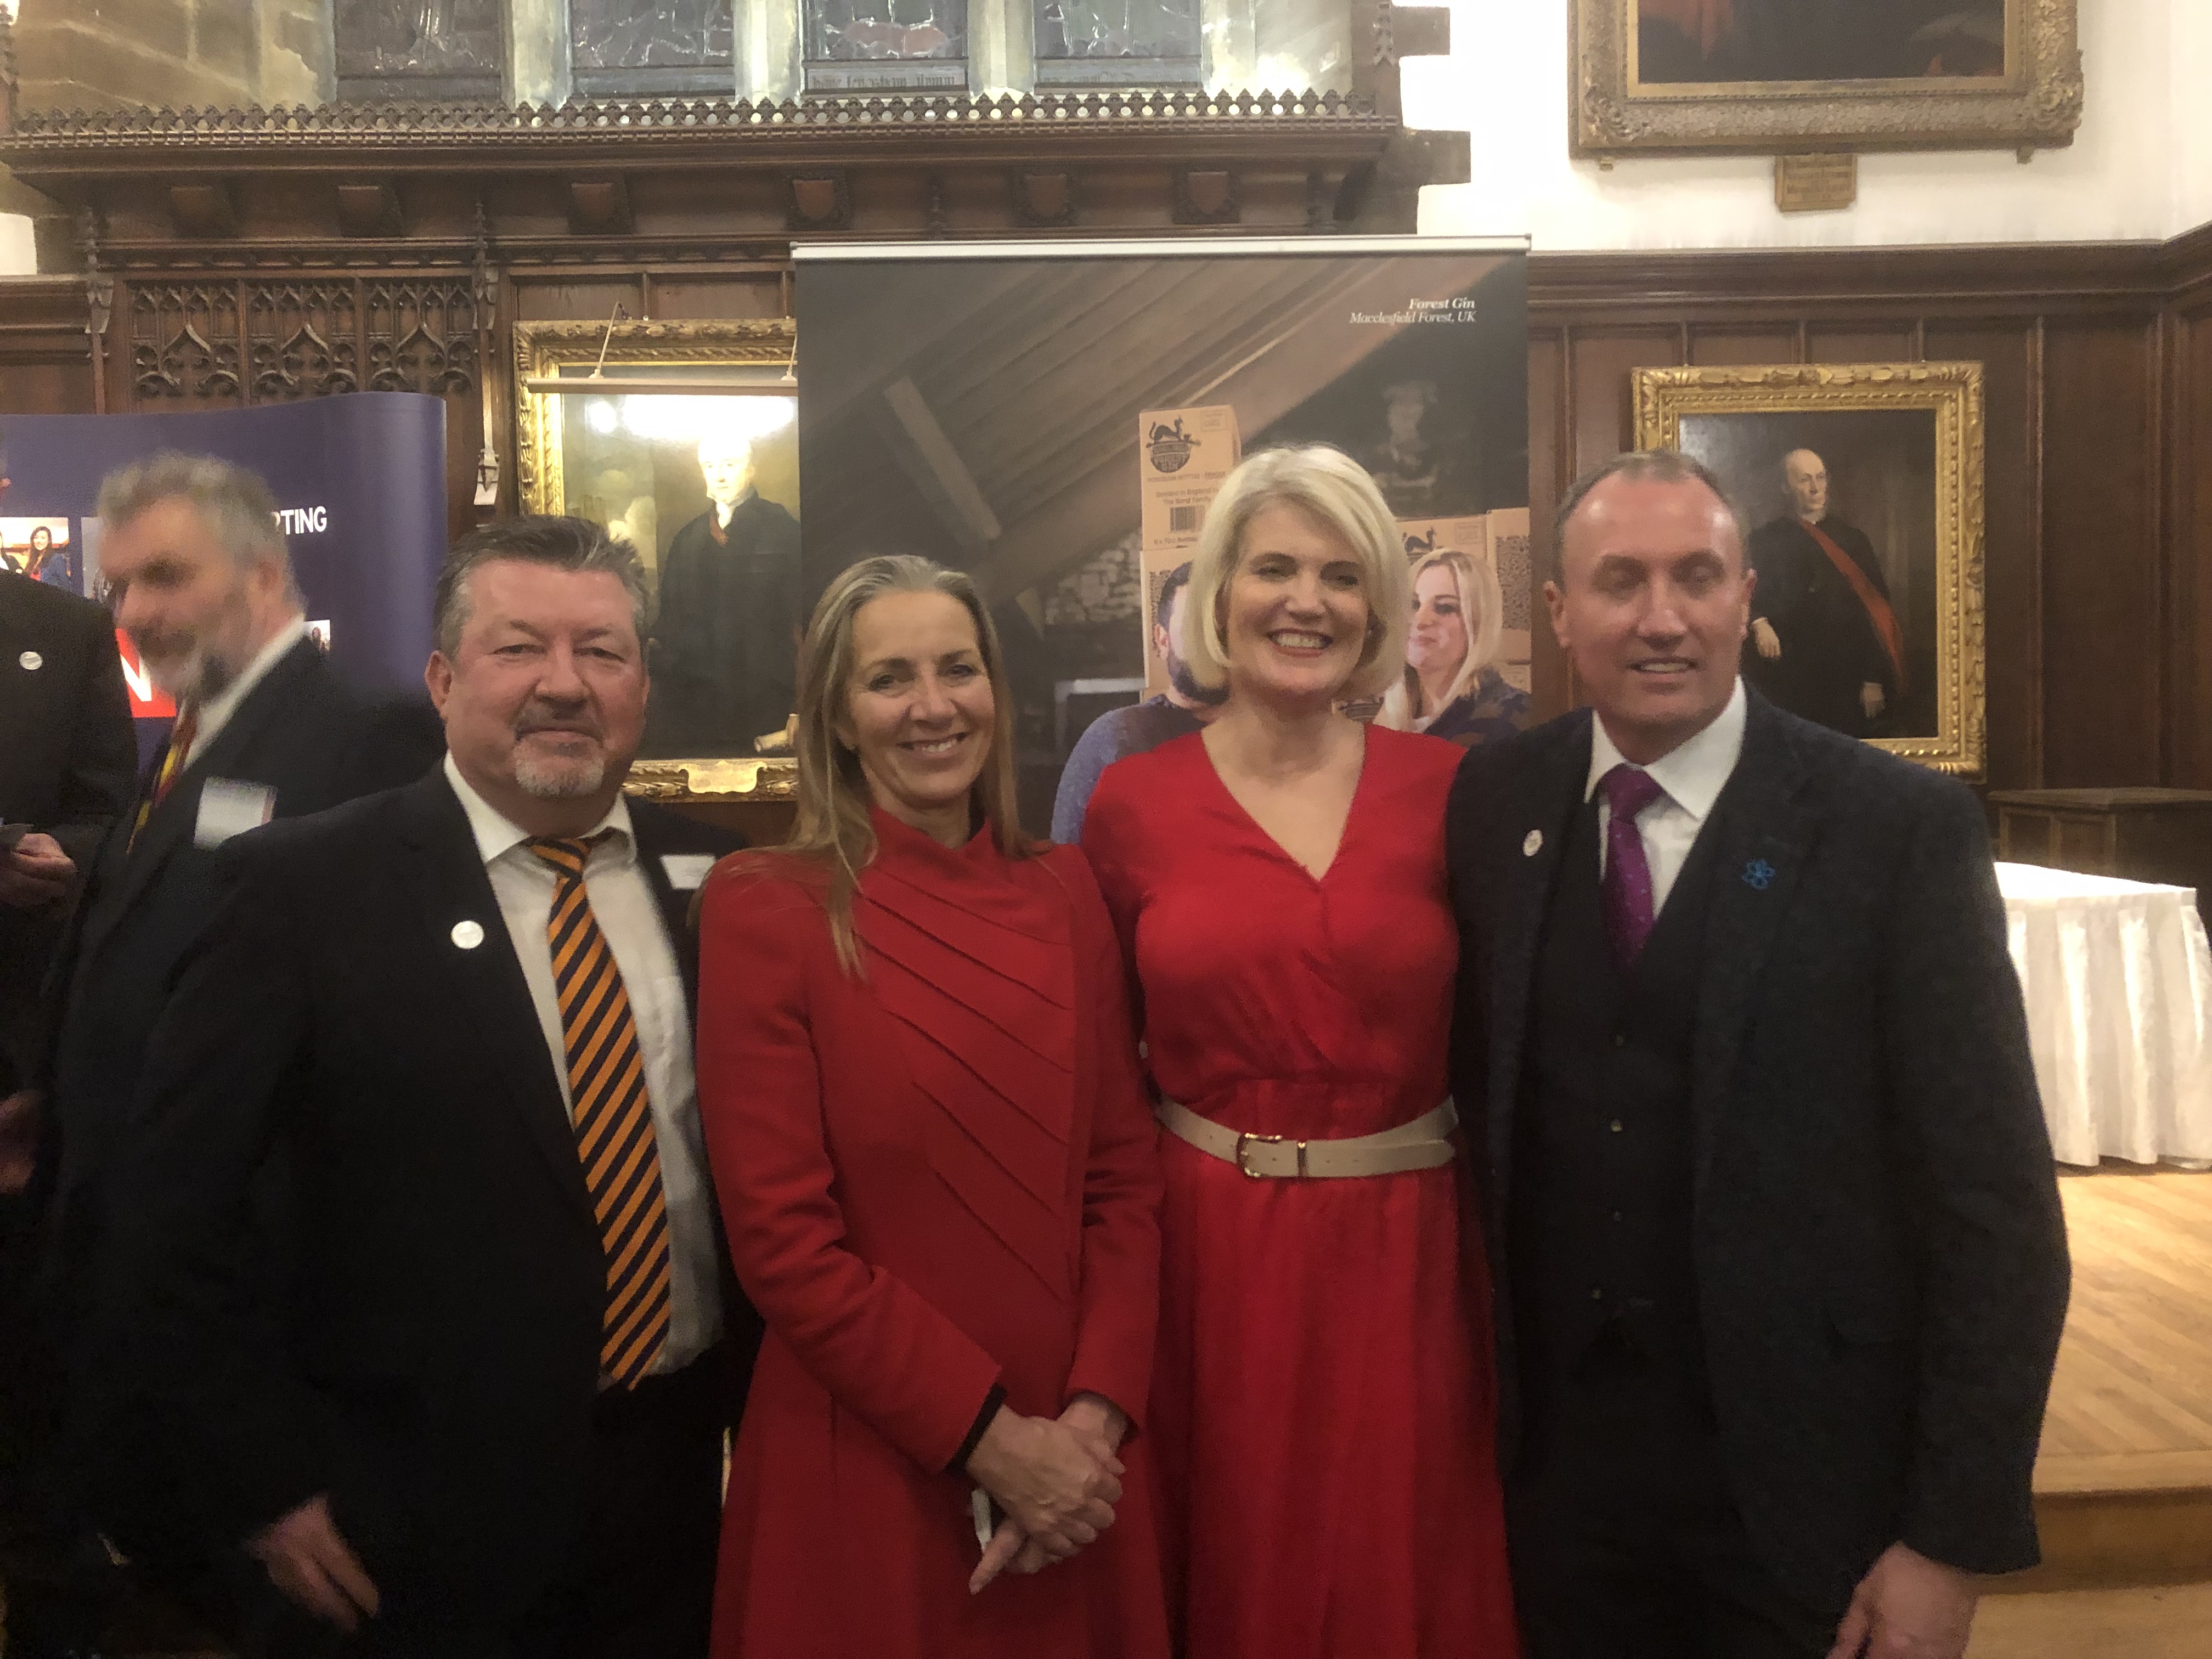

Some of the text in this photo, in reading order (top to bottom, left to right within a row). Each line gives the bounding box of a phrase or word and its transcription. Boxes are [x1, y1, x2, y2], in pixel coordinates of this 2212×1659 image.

[1409, 297, 1475, 309] Forest Gin
[1349, 311, 1478, 326] Macclesfield Forest, UK
